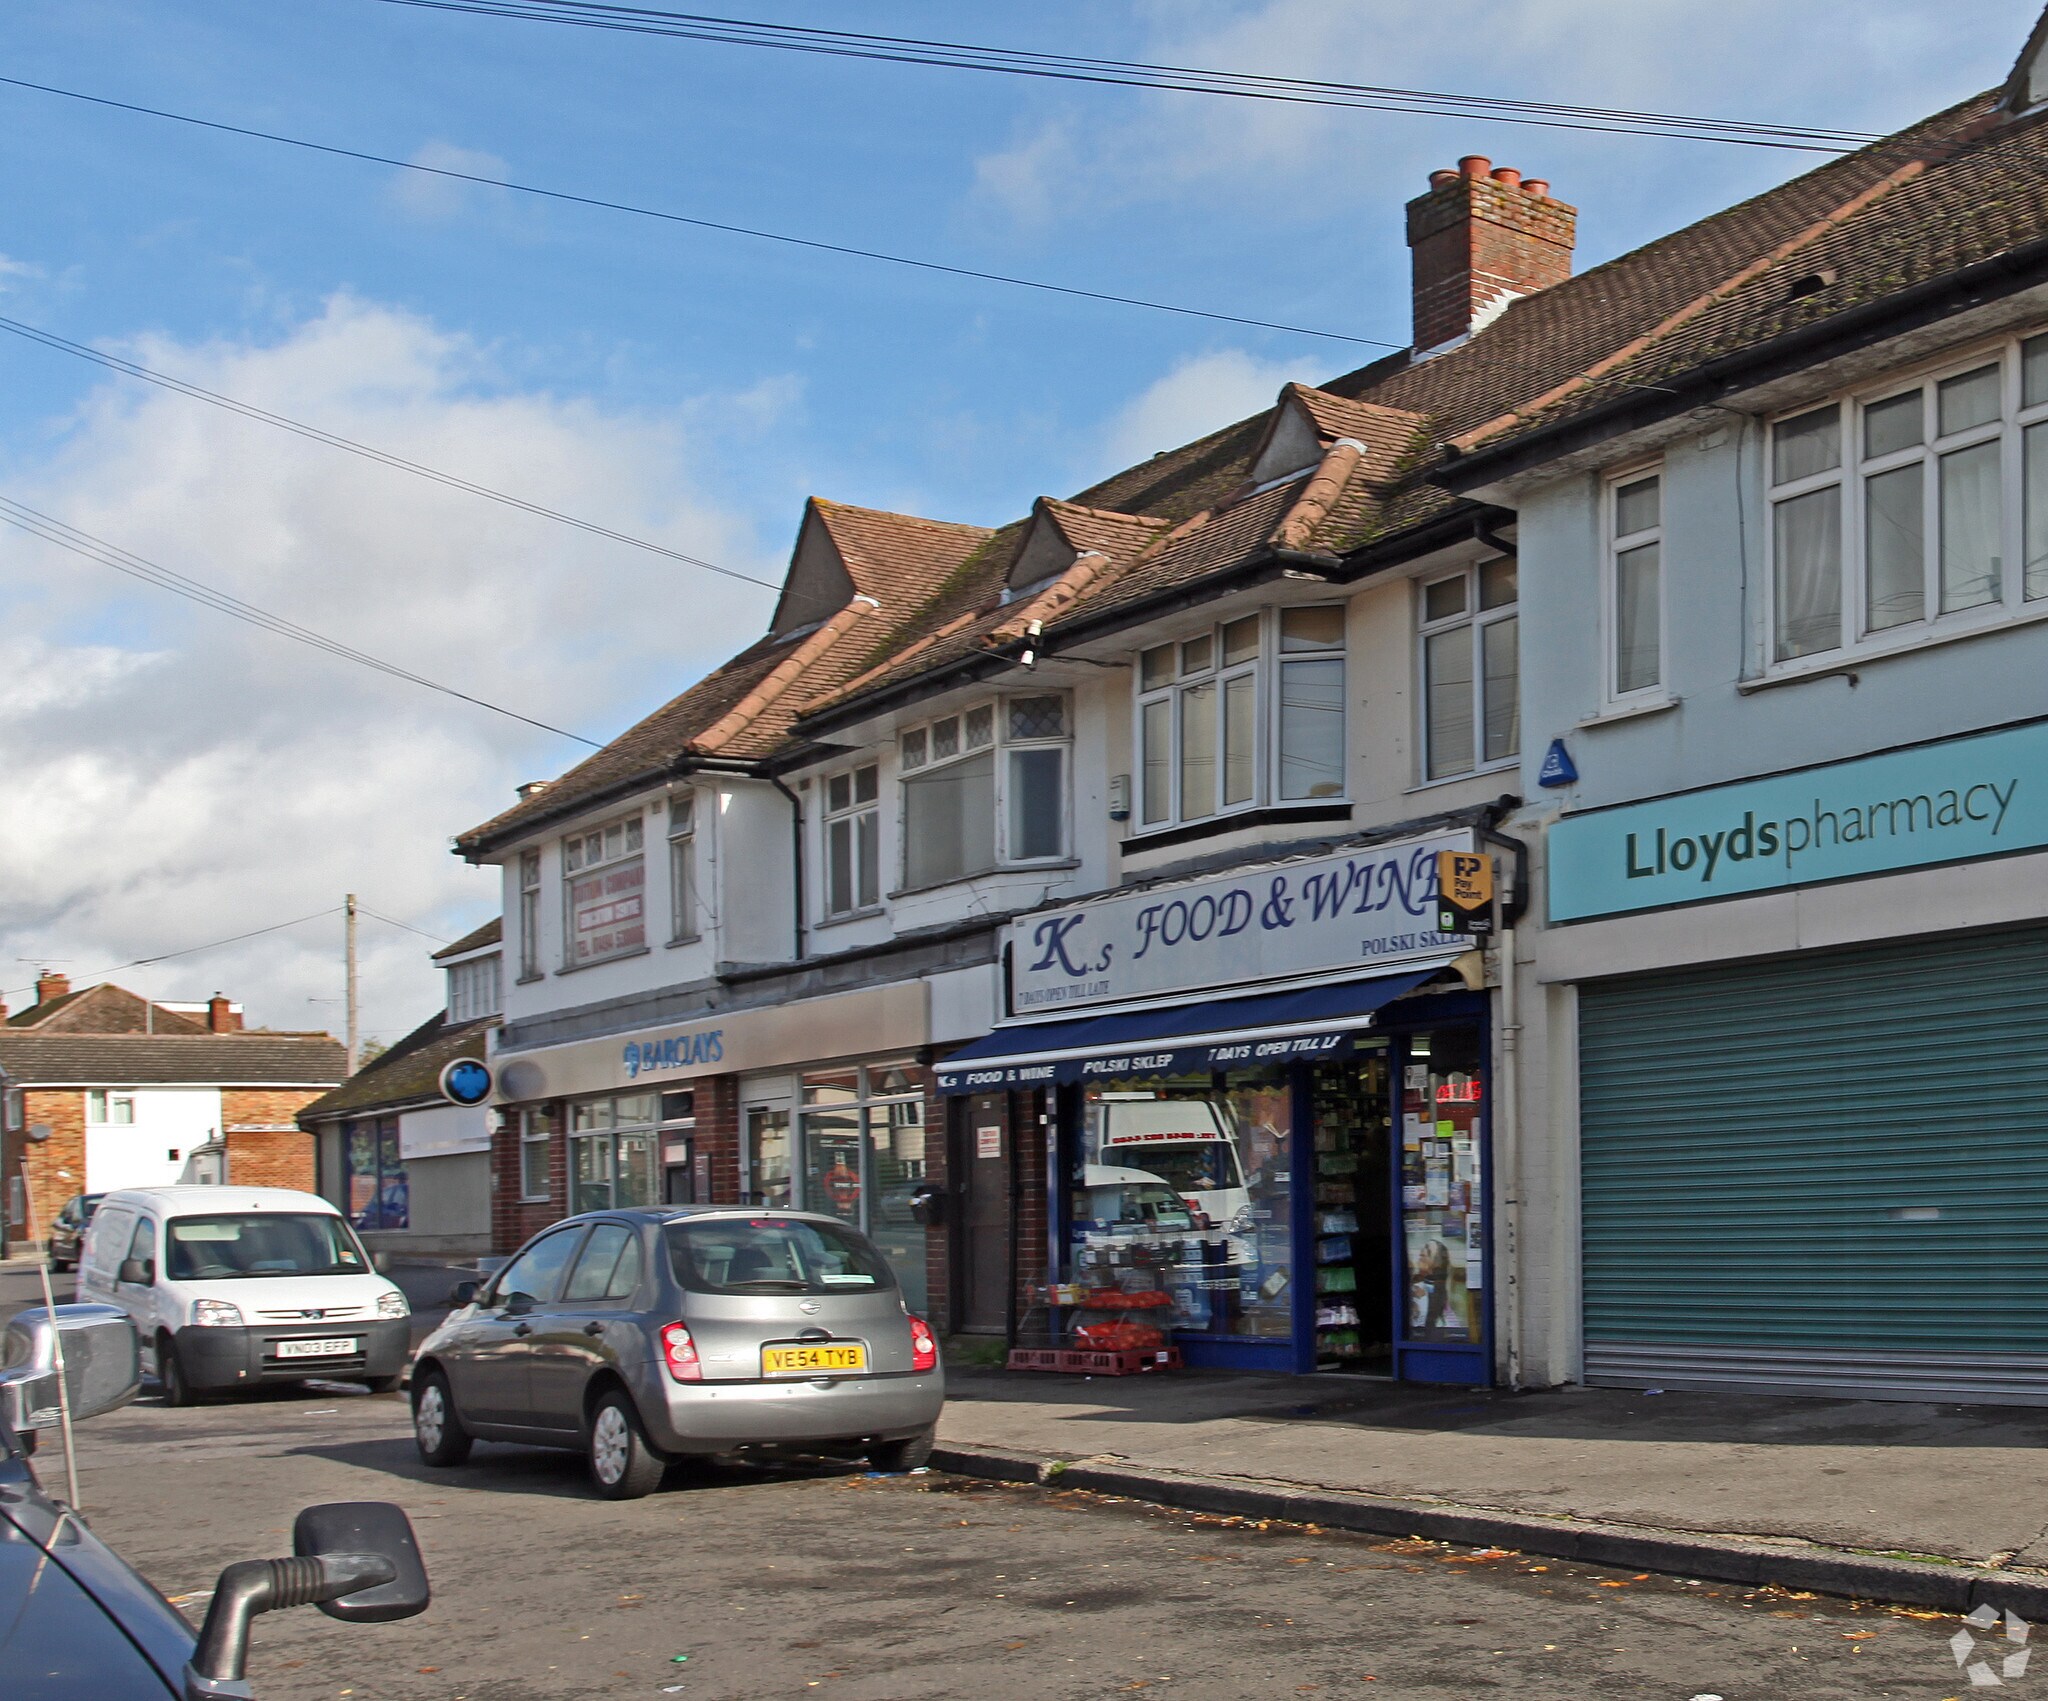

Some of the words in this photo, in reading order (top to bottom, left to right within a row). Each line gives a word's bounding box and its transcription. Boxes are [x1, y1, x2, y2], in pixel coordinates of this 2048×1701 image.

[1626, 779, 2019, 882] Lloydspharmacy
[1454, 878, 1473, 890] Pay
[1454, 889, 1482, 900] Point
[1132, 889, 1253, 960] FOOD
[1261, 876, 1296, 930] &
[1361, 933, 1415, 956] POLSKI
[1088, 980, 1110, 997] LATE
[642, 1030, 723, 1072] BARCLAYS
[1208, 1049, 1217, 1062] 7
[1216, 1045, 1252, 1060] DAYS
[1255, 1041, 1290, 1056] OPEN
[1292, 1038, 1320, 1051] TILL
[1082, 1057, 1130, 1074] POLSKI
[1131, 1054, 1173, 1070] SKLEP
[966, 1070, 1003, 1085] FOOD
[1006, 1069, 1016, 1082] &
[1019, 1066, 1056, 1081] WINE
[285, 1342, 321, 1355] VN03
[324, 1340, 350, 1353] EFP
[772, 1351, 819, 1368] VE54
[825, 1349, 857, 1365] TYB
